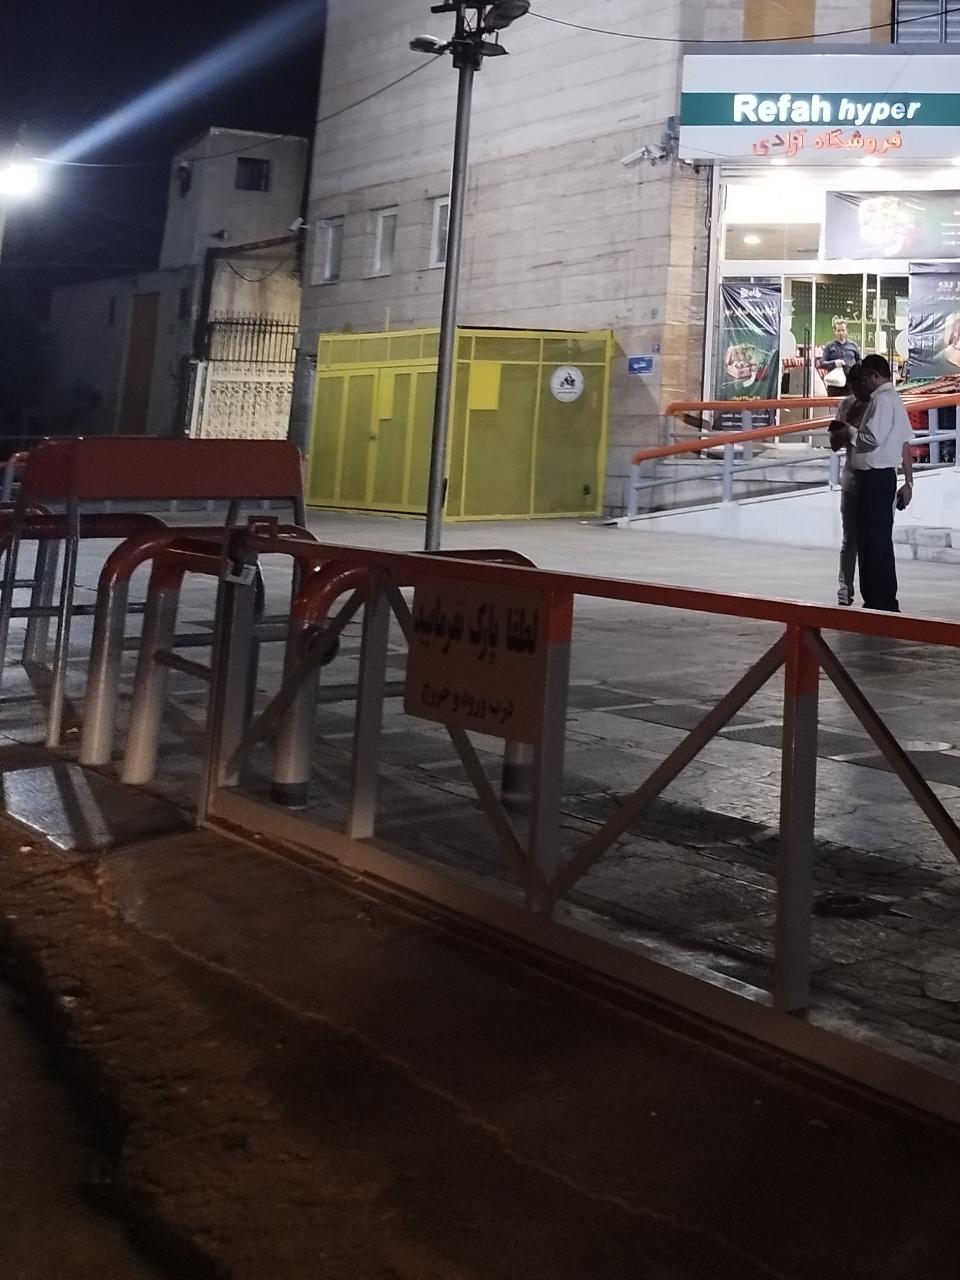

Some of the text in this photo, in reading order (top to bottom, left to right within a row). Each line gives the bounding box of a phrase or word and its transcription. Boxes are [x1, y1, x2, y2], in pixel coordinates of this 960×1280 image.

[733, 94, 921, 125] Refah hyper
[752, 128, 903, 156] فروشگاه آزادی
[506, 607, 539, 654] لطفا
